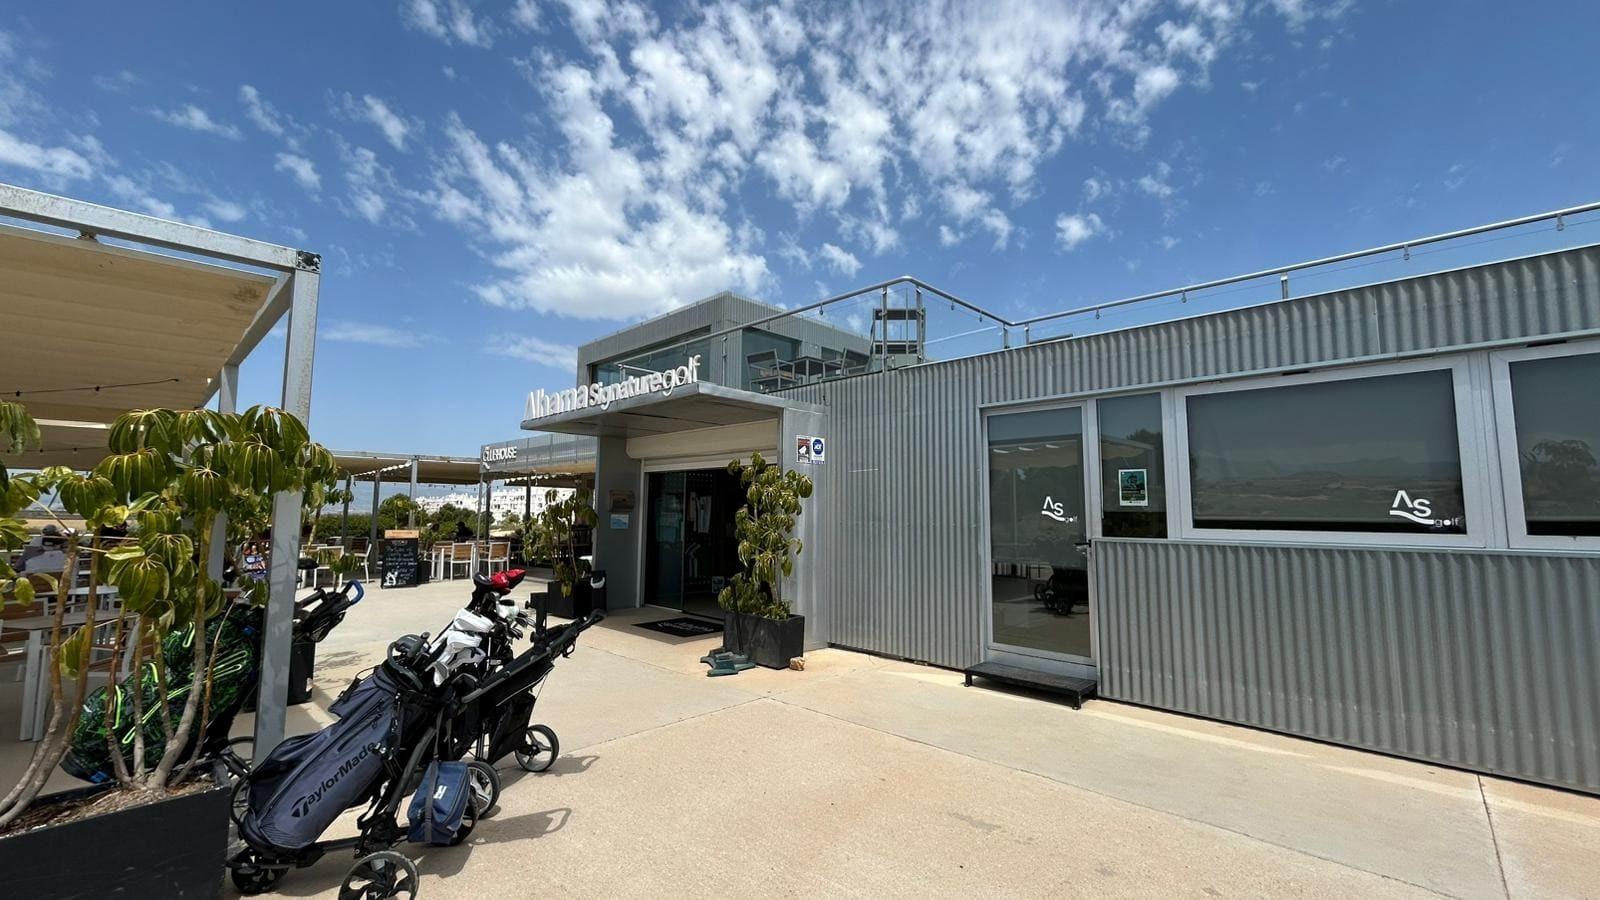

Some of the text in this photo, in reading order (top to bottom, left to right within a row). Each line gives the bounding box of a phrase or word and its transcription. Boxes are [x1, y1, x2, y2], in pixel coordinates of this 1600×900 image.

[524, 386, 588, 420] Alhama
[662, 355, 701, 396] golf
[1434, 518, 1458, 527] golf
[291, 742, 378, 817] TaylorMade
